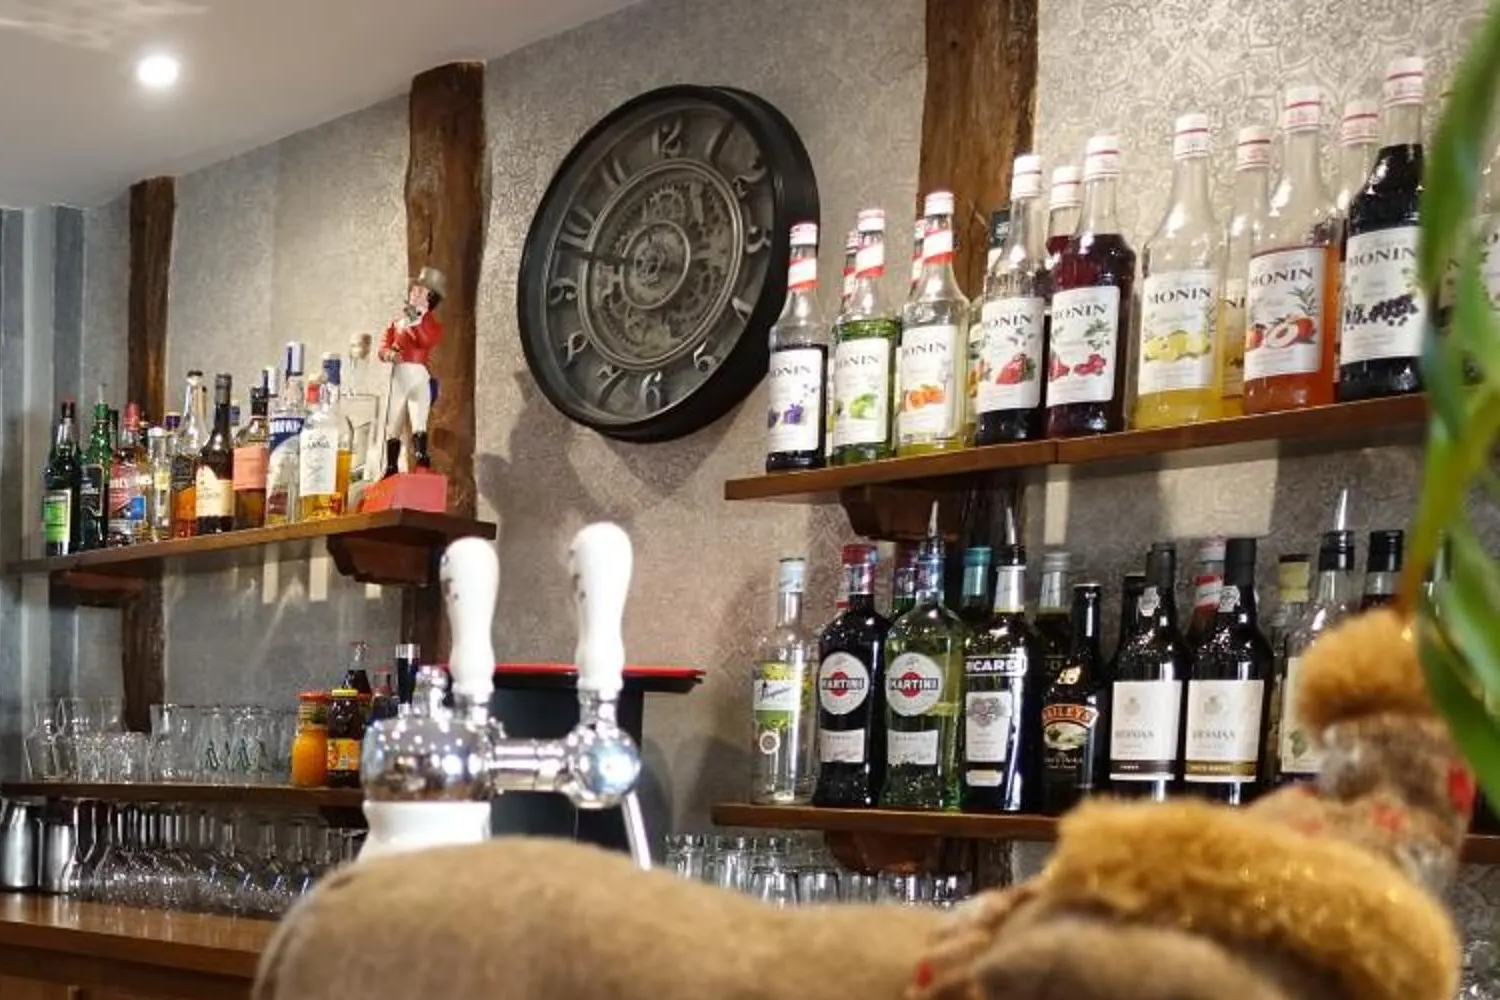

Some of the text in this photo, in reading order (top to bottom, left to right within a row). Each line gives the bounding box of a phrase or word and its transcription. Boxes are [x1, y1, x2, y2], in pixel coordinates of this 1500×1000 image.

[653, 115, 682, 158] 12
[706, 119, 735, 158] 1
[602, 155, 629, 188] 11
[733, 154, 767, 198] 2
[559, 206, 596, 252] 10
